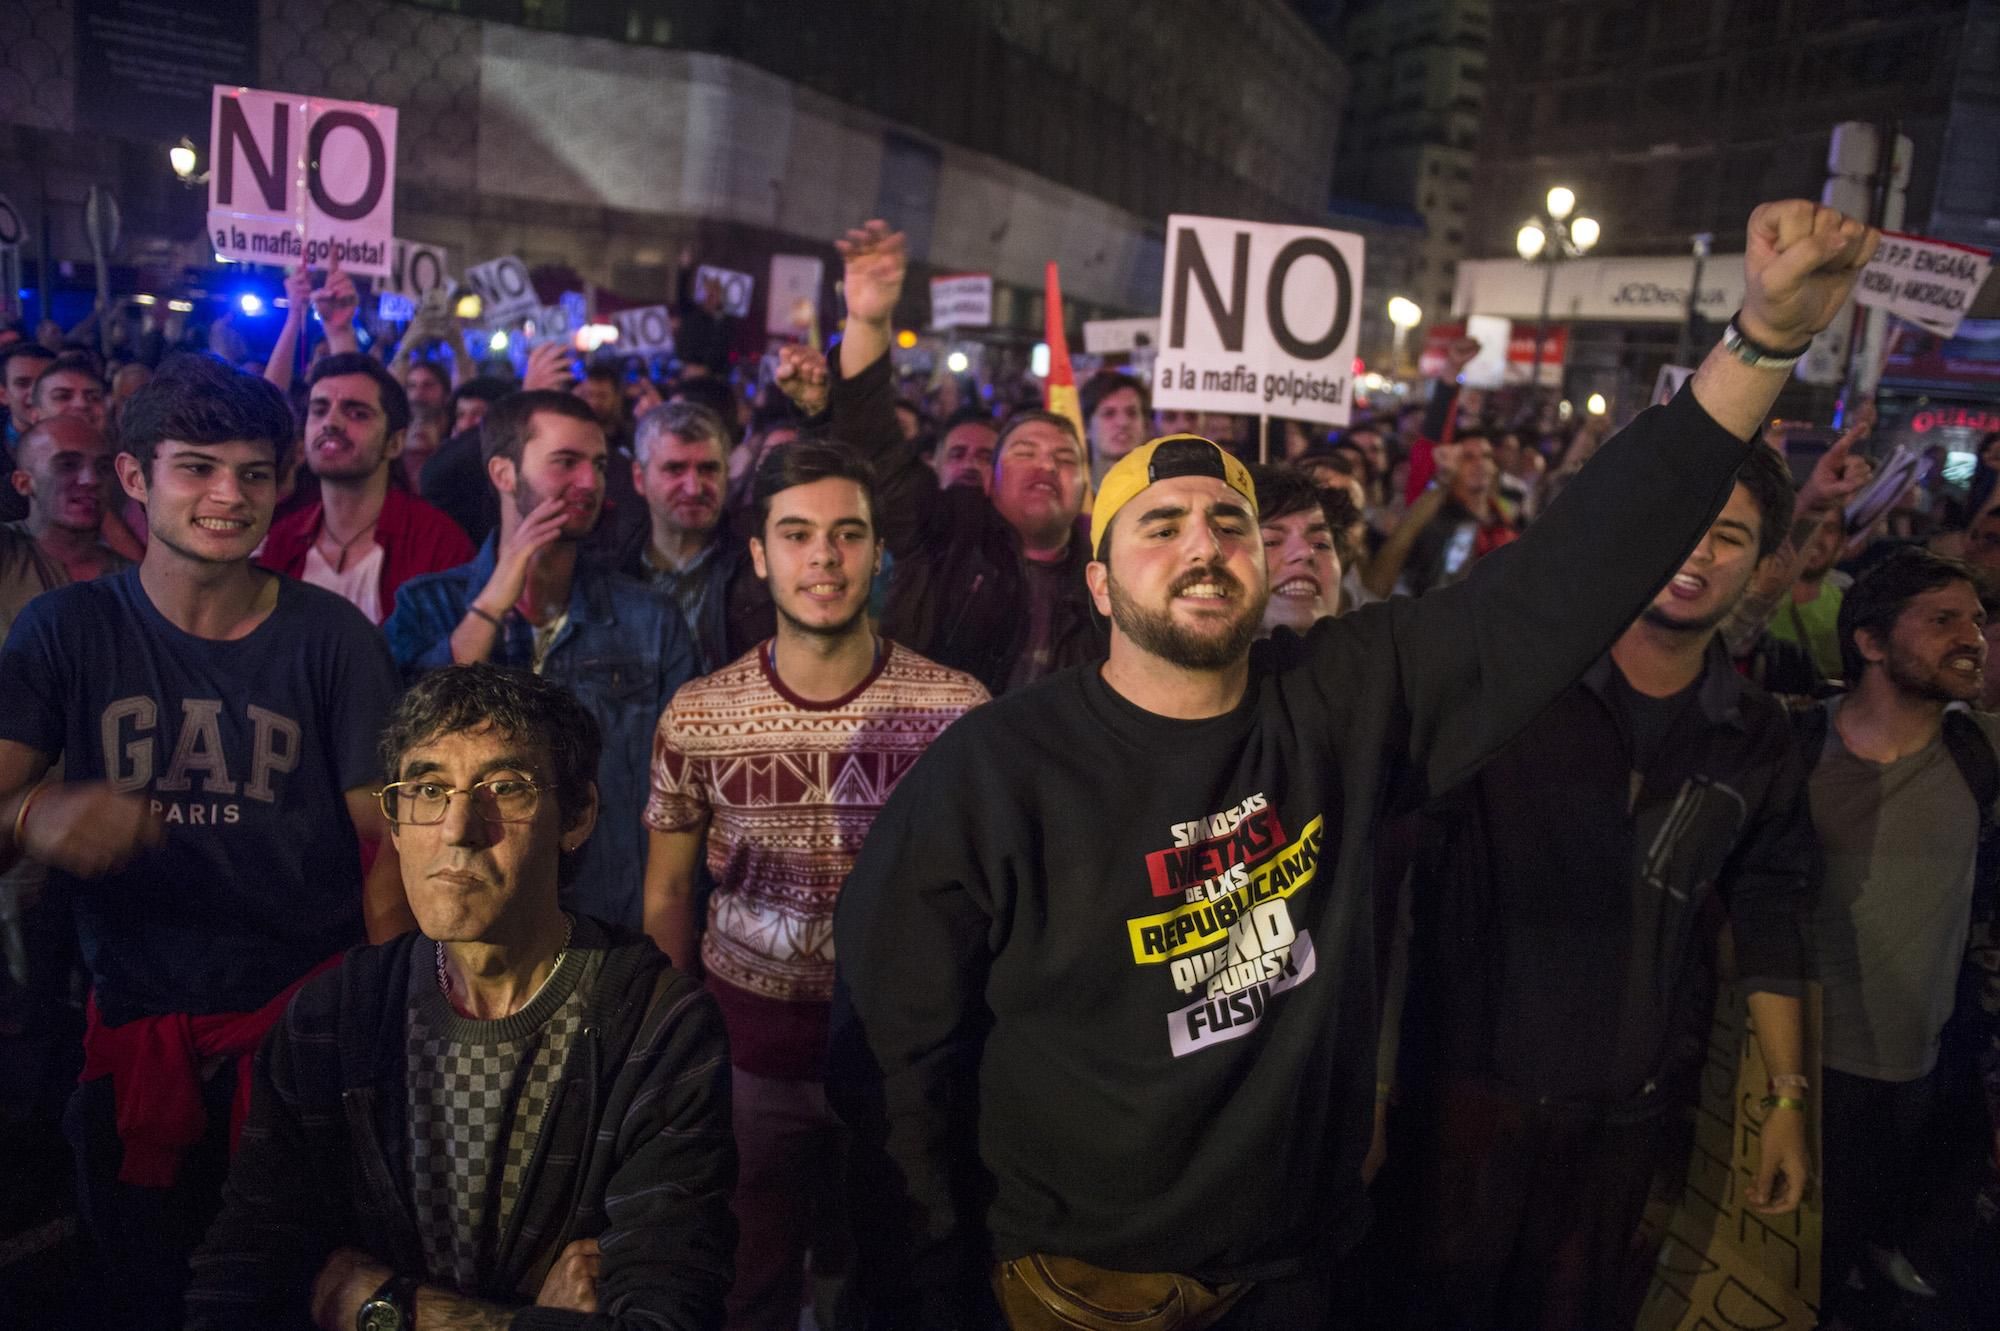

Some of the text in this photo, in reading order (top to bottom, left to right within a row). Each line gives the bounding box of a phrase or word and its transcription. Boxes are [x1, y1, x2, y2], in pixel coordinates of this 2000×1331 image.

[217, 95, 387, 221] NO
[216, 229, 226, 248] a
[231, 225, 246, 250] la
[252, 230, 302, 254] mafia
[1169, 227, 1354, 361] NO
[1161, 362, 1345, 405] a la mafia golpista!
[102, 695, 301, 804] GAP
[151, 799, 241, 825] PARIS
[1185, 862, 1249, 903] DE LXS
[1170, 898, 1296, 994] QUE NO
